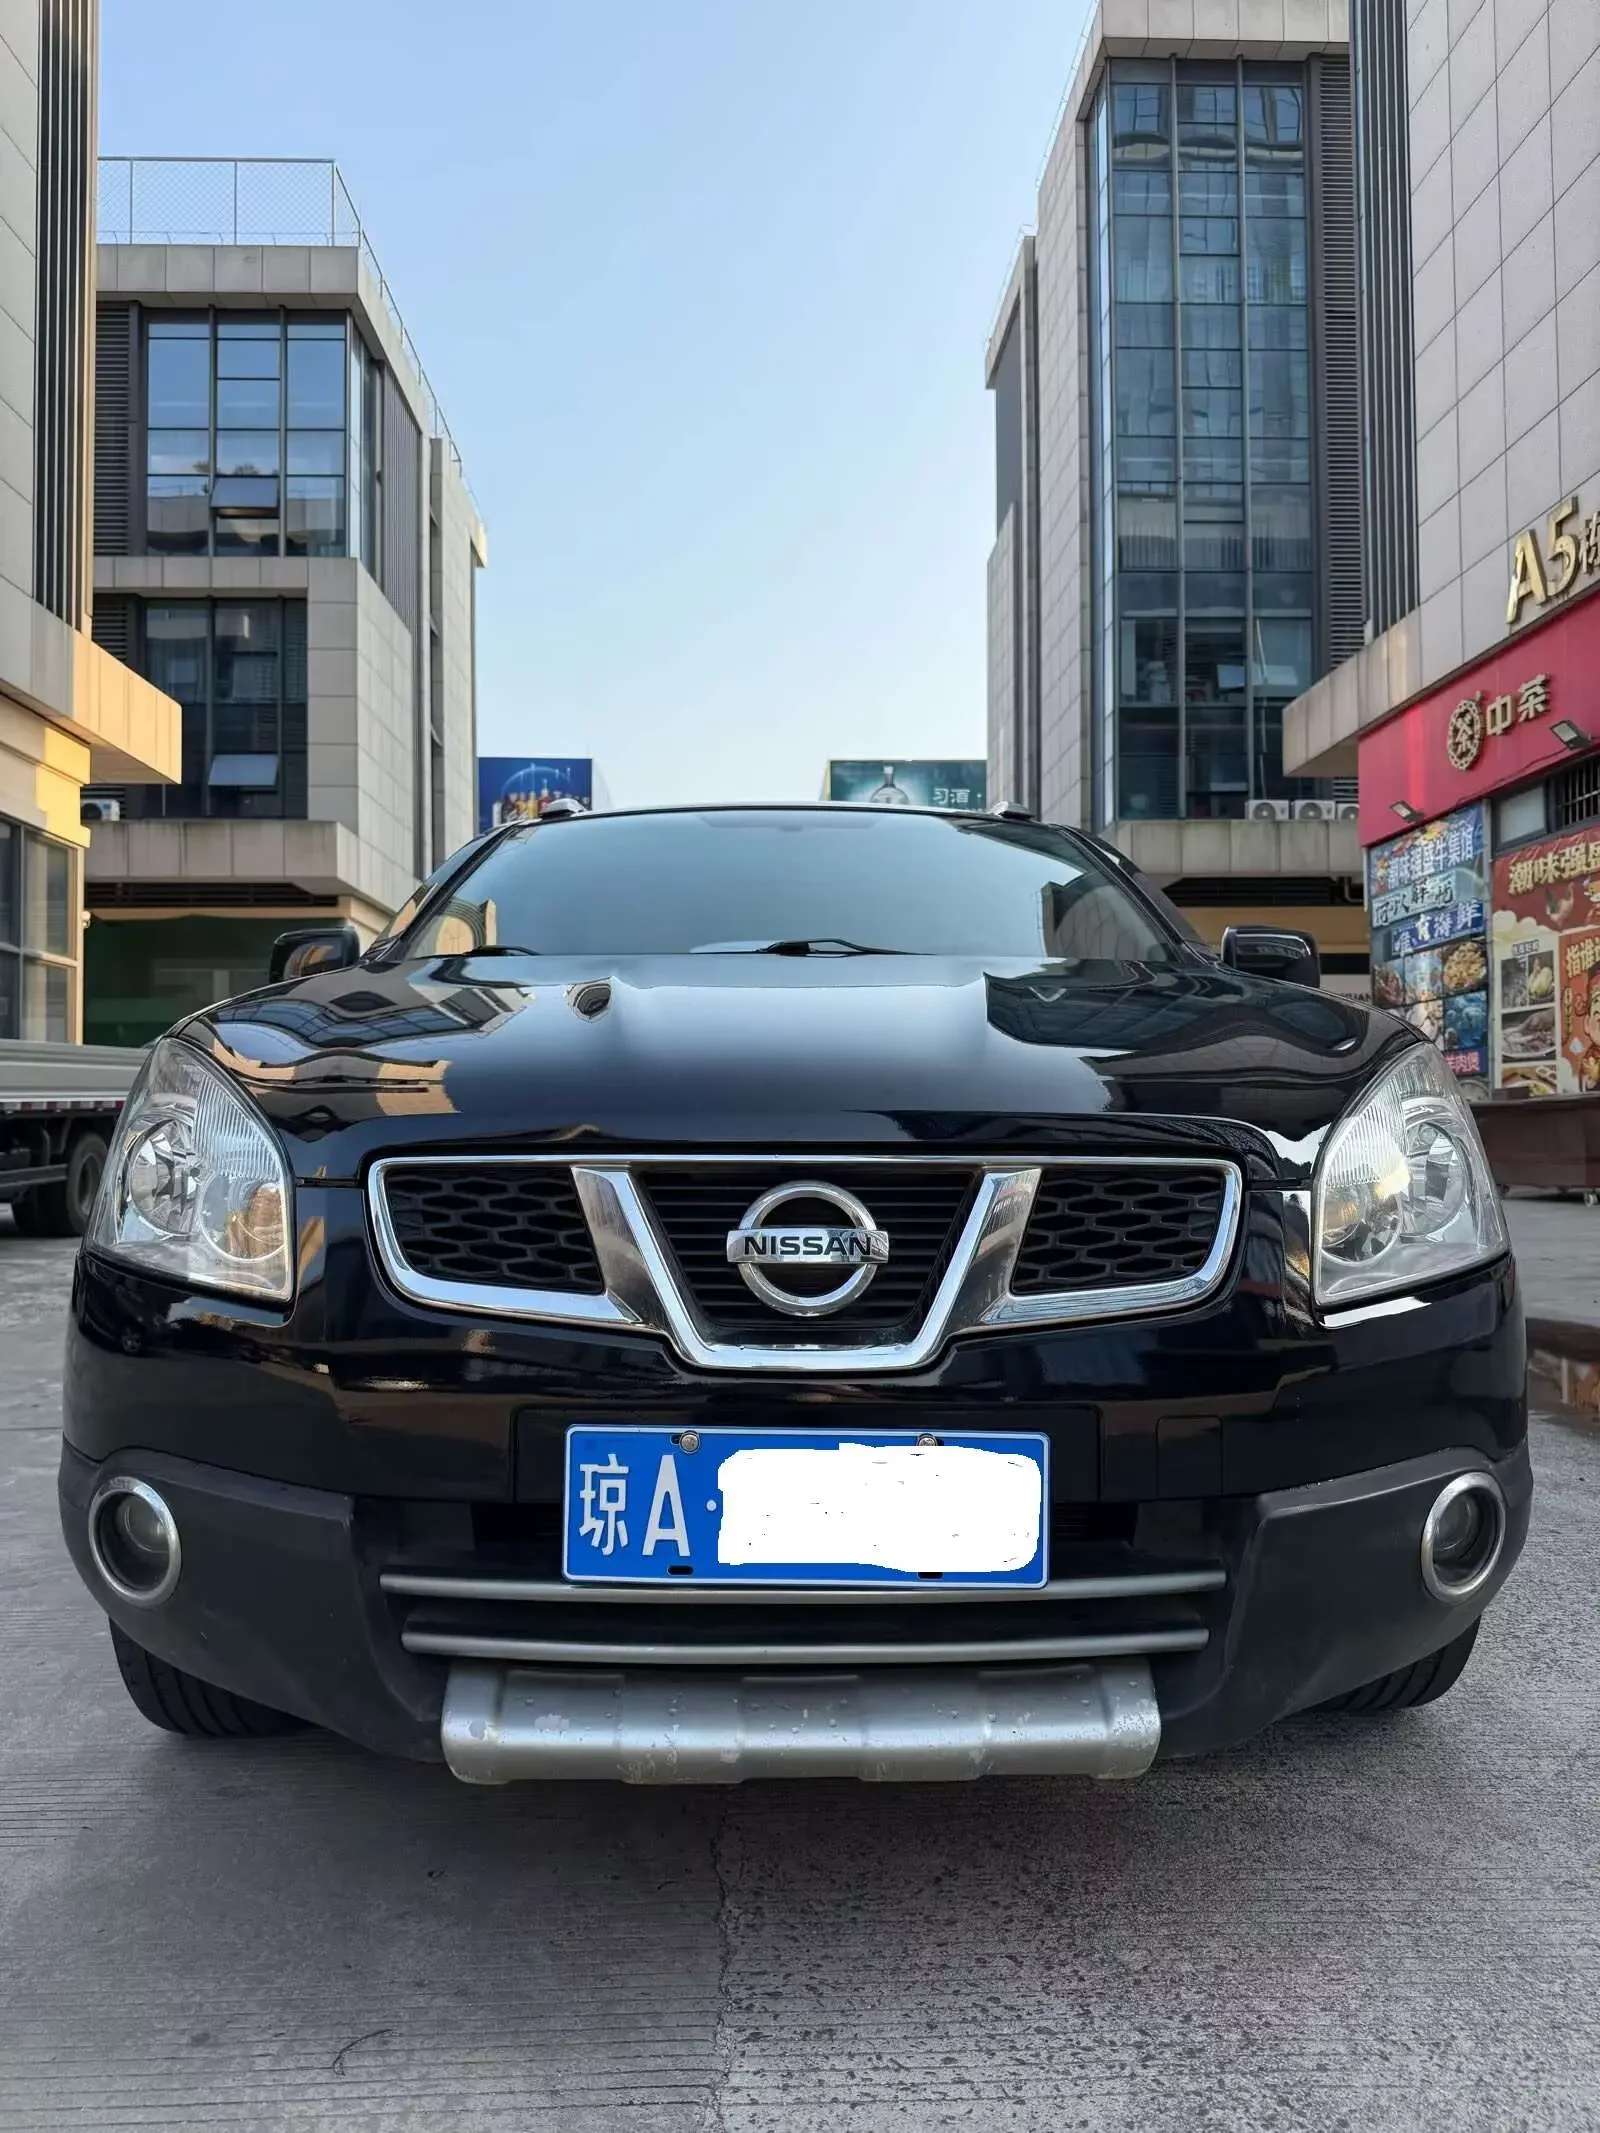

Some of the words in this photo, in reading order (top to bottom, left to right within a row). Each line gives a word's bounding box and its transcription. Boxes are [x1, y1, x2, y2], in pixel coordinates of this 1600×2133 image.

[1486, 672, 1551, 737] 中茶
[932, 787, 971, 804] 习酒
[744, 1236, 872, 1256] NISSAN
